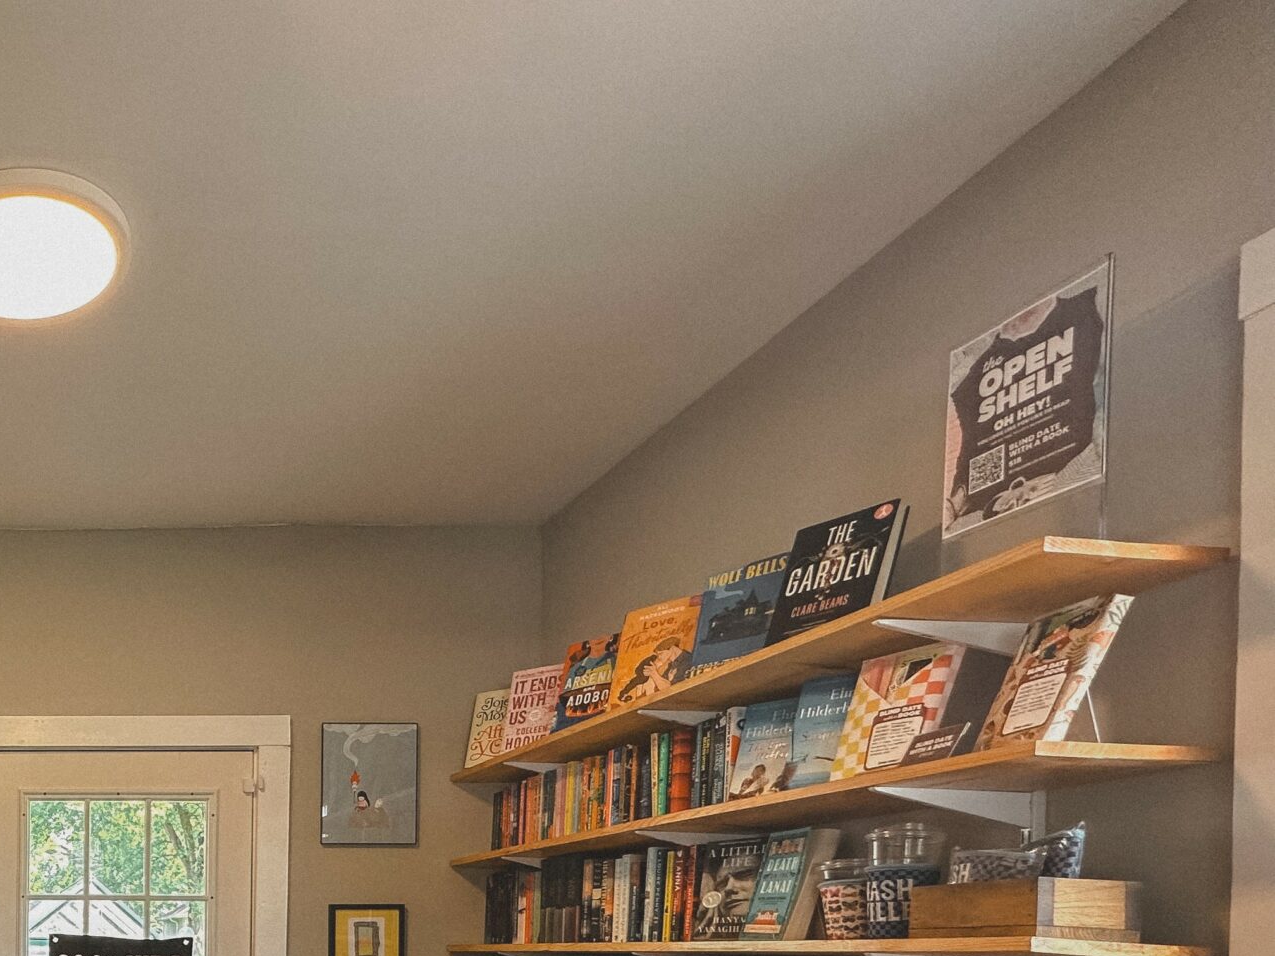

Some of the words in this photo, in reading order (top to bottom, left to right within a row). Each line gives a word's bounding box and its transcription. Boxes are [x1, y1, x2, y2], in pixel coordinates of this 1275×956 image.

[979, 327, 1074, 397] OPEN
[977, 354, 1073, 422] SHELF
[993, 413, 1014, 431] OH
[1017, 395, 1051, 420] HEY!
[826, 520, 858, 546] THE
[708, 567, 743, 590] WOLF
[745, 555, 788, 580] BELLS
[785, 546, 878, 598] GARDEN
[790, 602, 818, 618] CLARE
[819, 594, 850, 612] BEAMS
[515, 680, 528, 695] IT
[512, 692, 547, 710] WITH
[566, 690, 609, 708] ADOBO
[509, 710, 527, 725] US
[709, 849, 716, 858] A
[723, 858, 752, 867] LIFE
[766, 856, 800, 872] DEATH
[760, 879, 792, 894] LANAI
